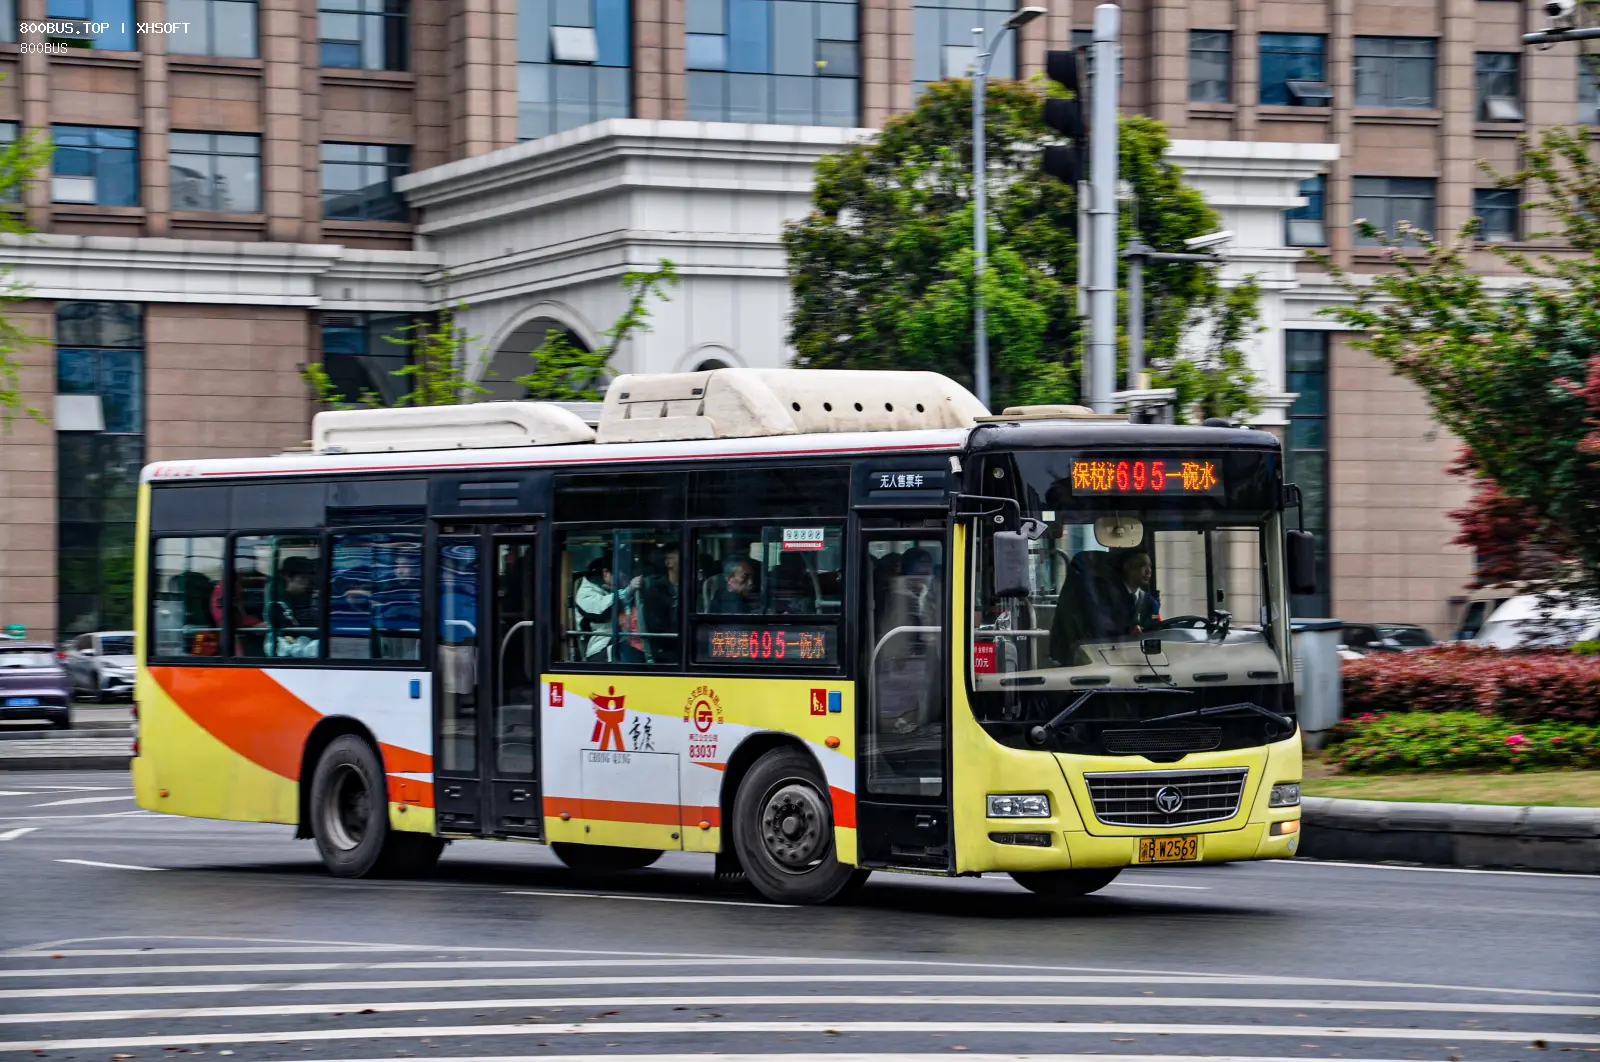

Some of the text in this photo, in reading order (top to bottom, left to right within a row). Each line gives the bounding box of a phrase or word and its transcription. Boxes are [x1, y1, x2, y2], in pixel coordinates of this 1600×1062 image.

[880, 474, 923, 488] 无人售票车
[689, 745, 717, 758] 83037
